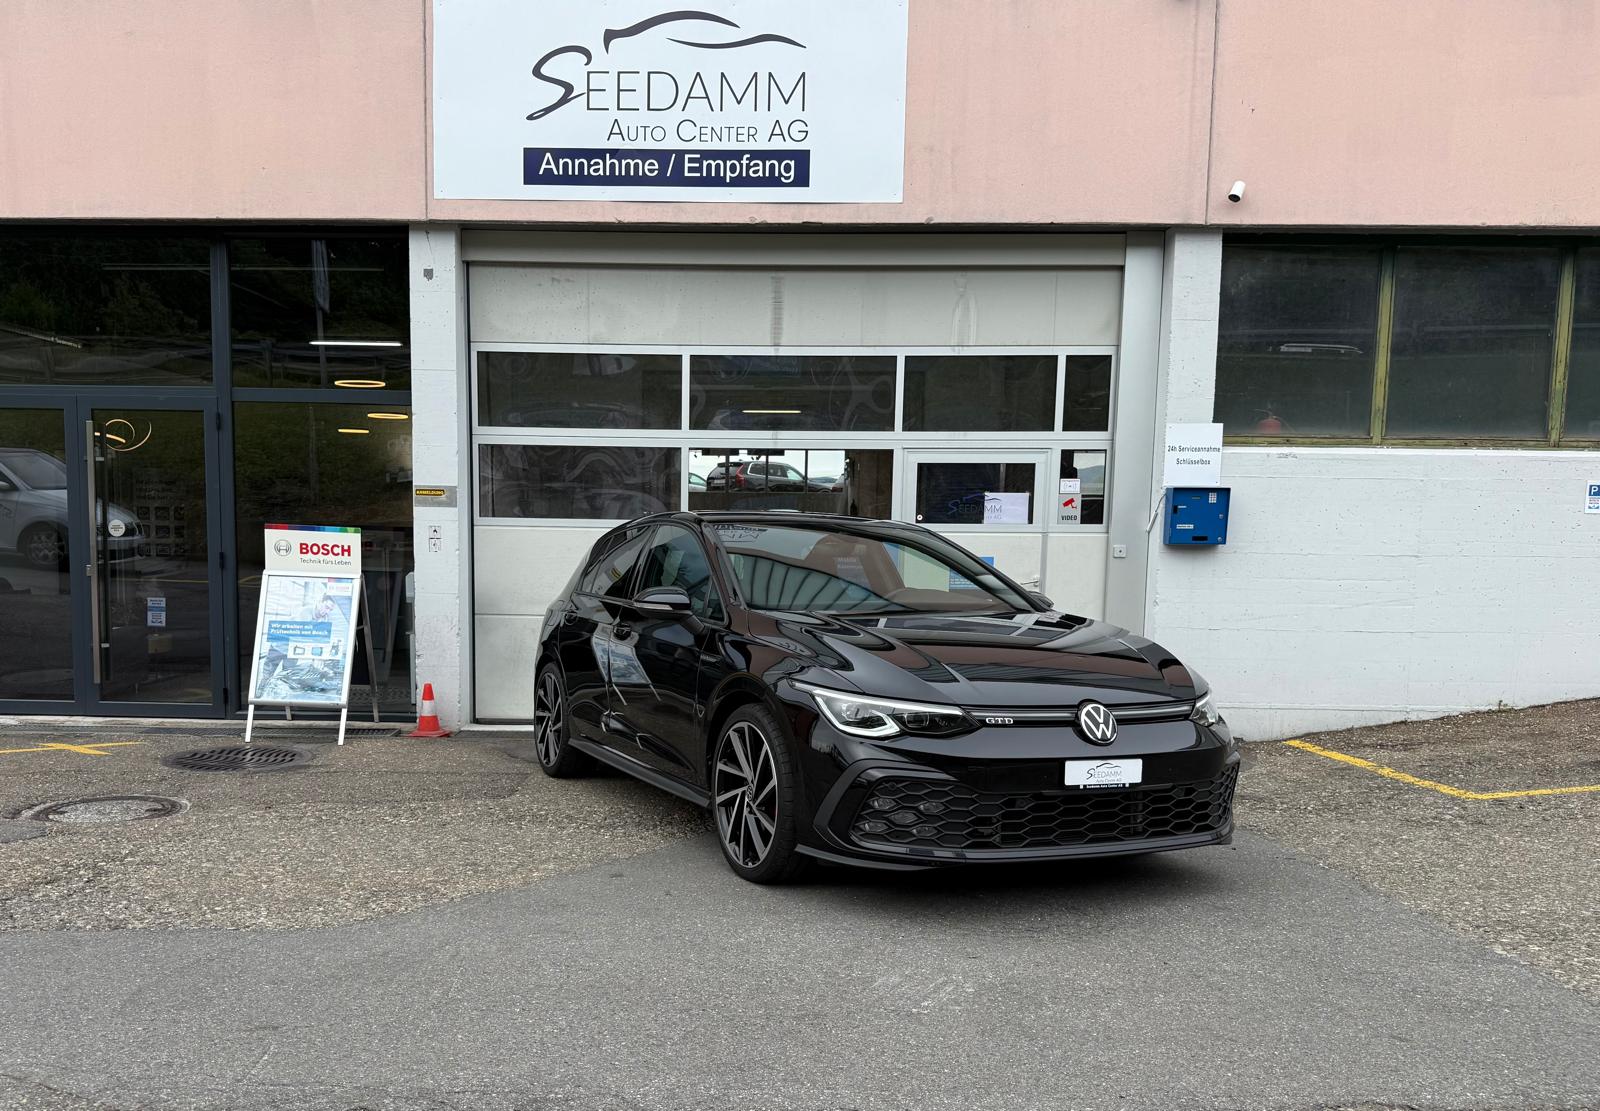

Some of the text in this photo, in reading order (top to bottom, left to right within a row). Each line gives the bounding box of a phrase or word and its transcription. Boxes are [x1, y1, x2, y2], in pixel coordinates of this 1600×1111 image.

[526, 45, 808, 121] SEEDAMM
[607, 119, 809, 143] AUTO CENTER AG
[539, 152, 796, 183] Annahme / Empfang
[1167, 445, 1221, 453] 24h Serviceannahme
[1591, 486, 1599, 495] P
[299, 543, 351, 557] BOSCH
[300, 557, 322, 565] Technik
[985, 716, 1014, 724] GTD
